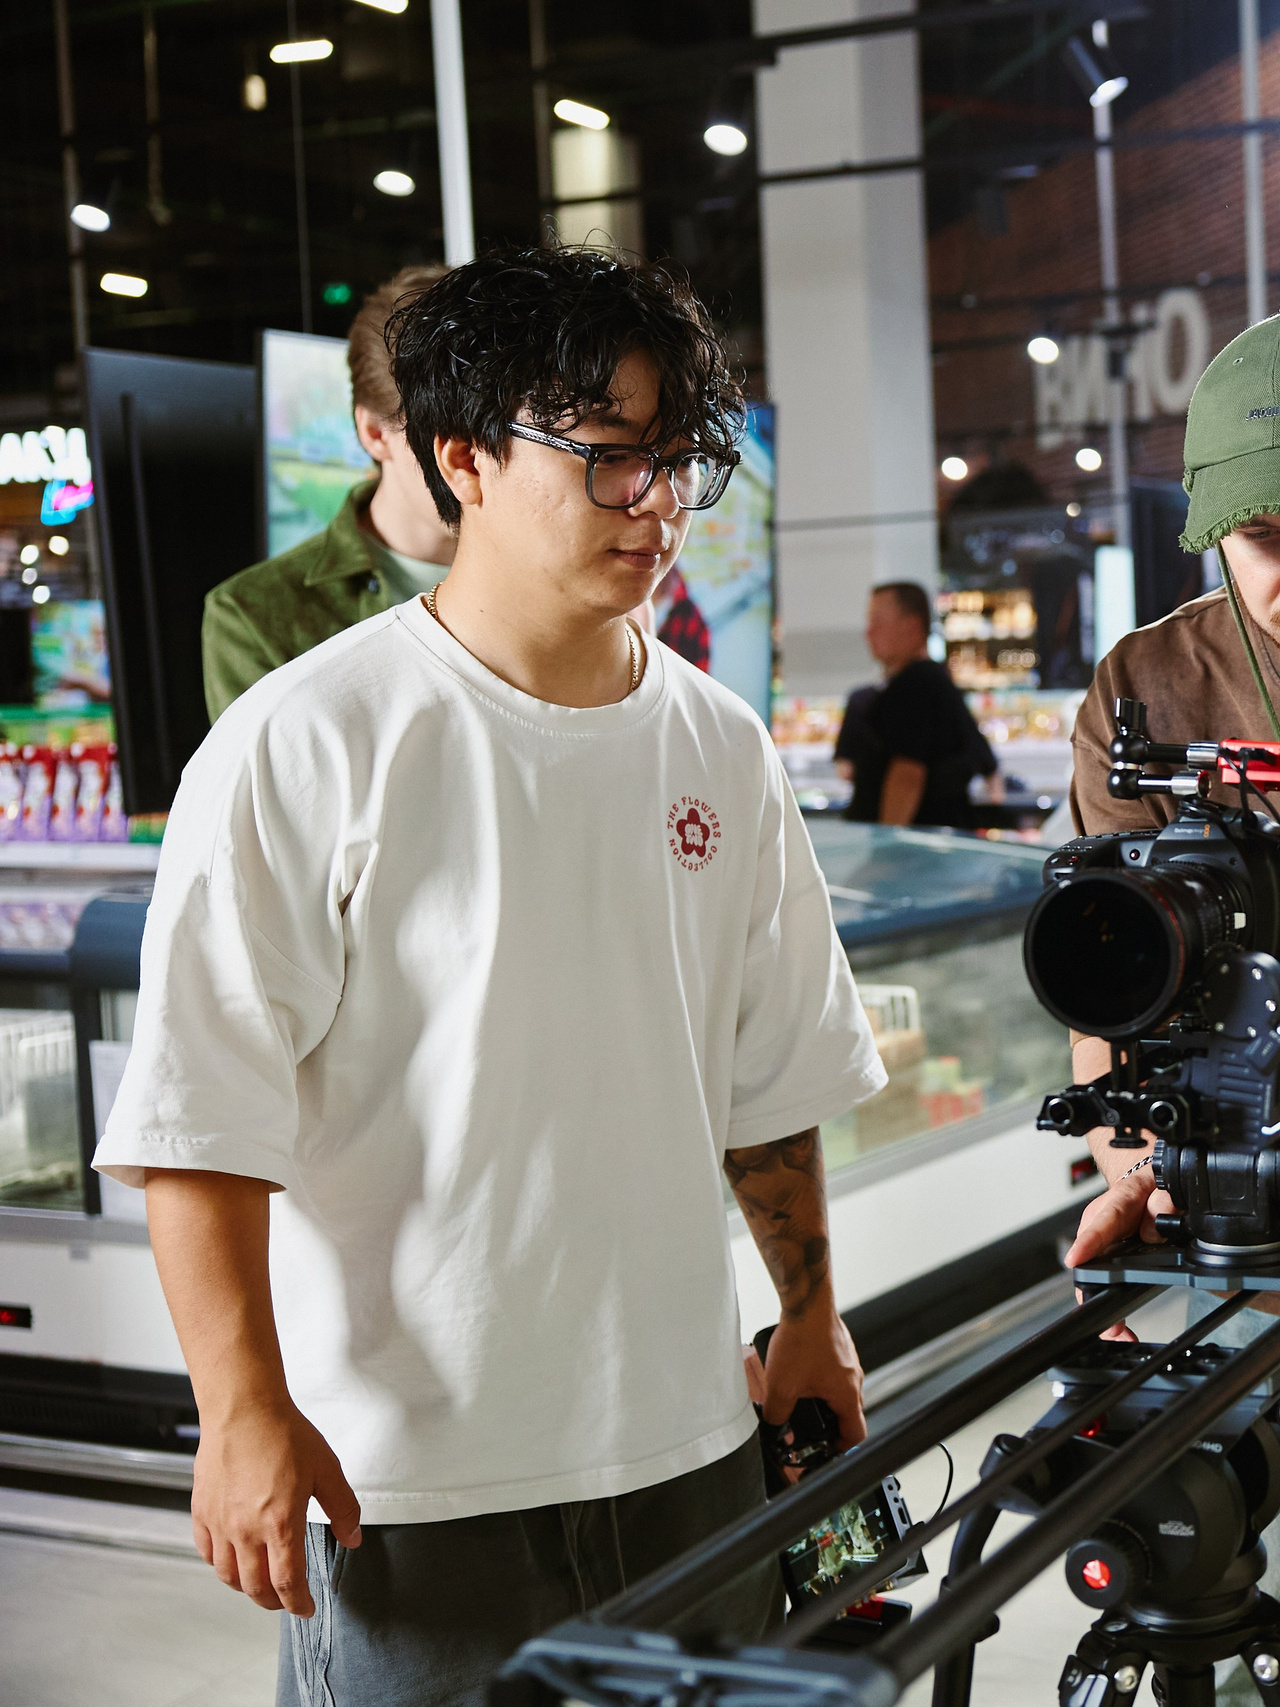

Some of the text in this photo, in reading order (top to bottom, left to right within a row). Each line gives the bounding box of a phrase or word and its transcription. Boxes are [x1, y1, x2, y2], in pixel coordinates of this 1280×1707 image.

[667, 803, 679, 829] THE
[681, 796, 721, 838] FLOWERS
[669, 838, 717, 871] COLLECTION
